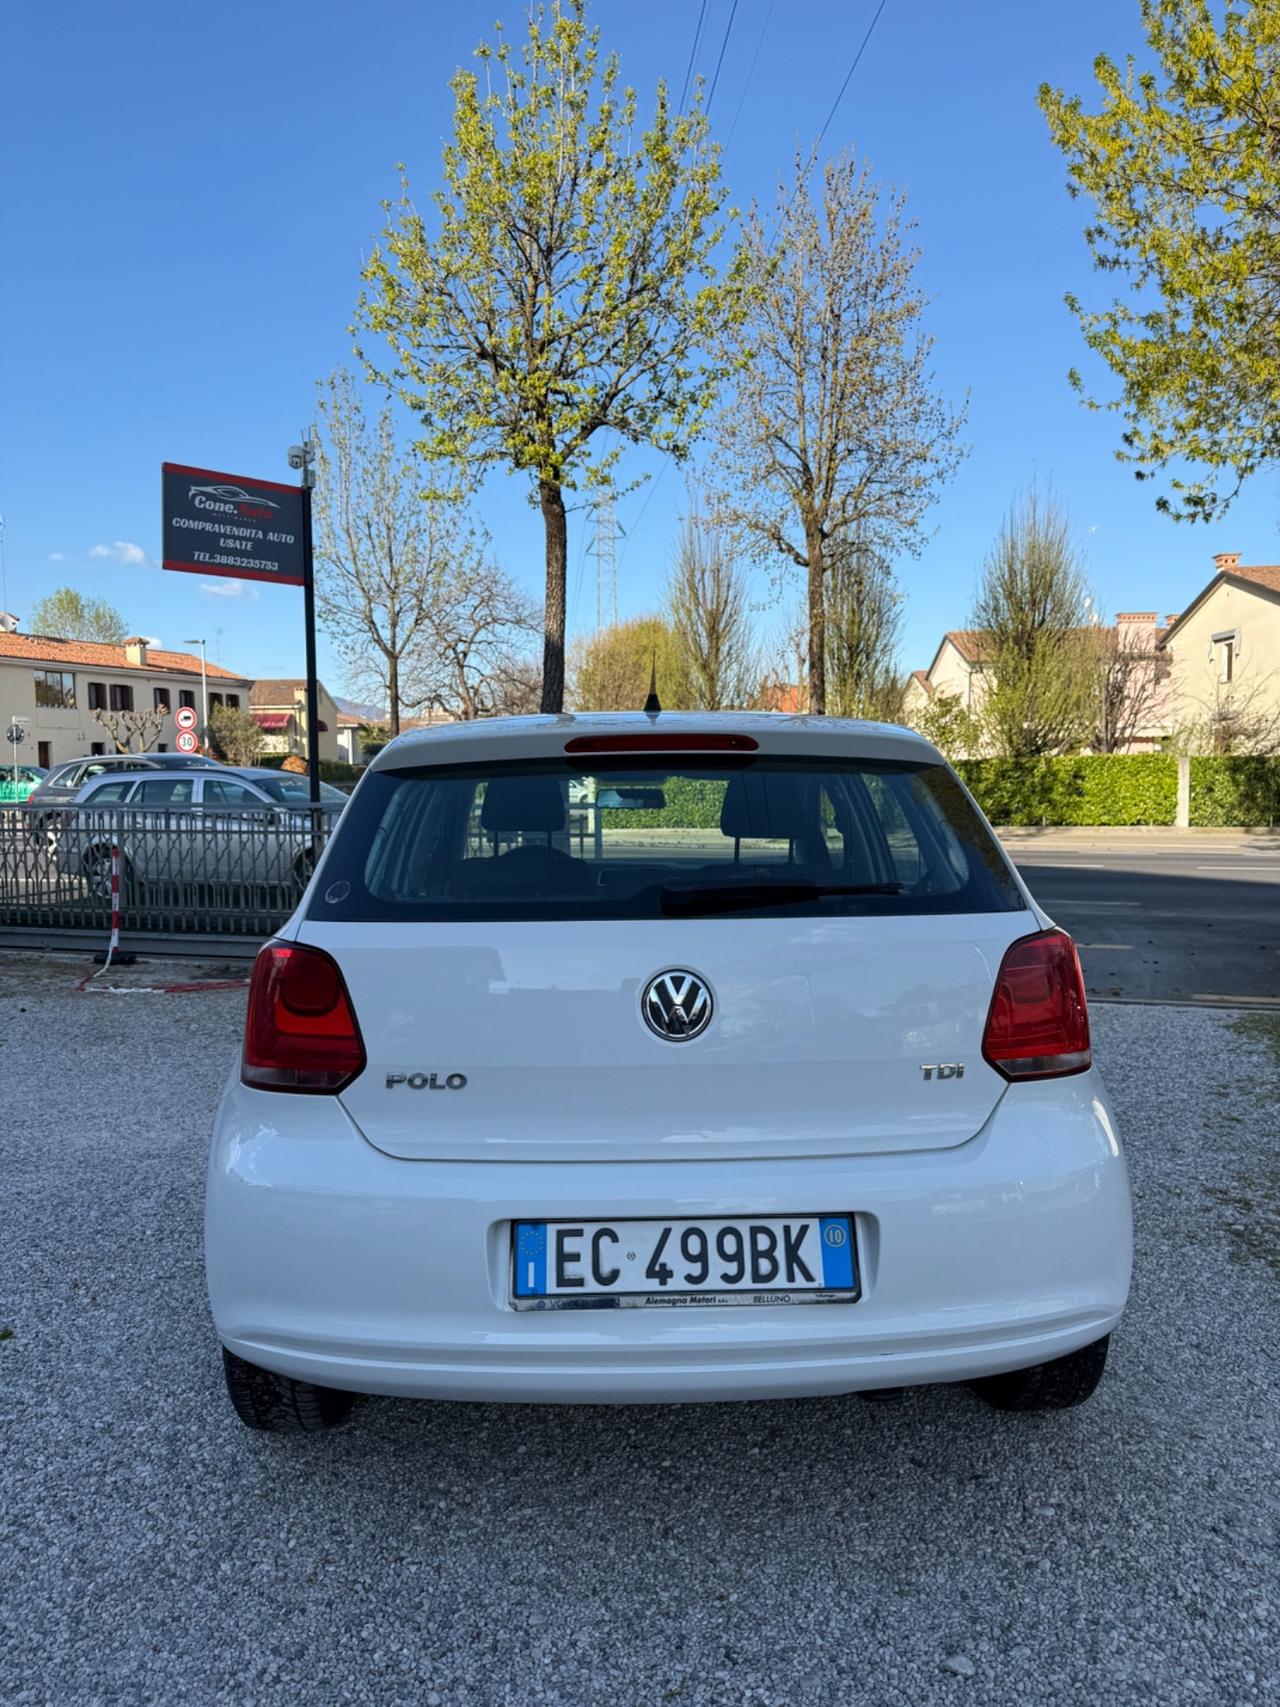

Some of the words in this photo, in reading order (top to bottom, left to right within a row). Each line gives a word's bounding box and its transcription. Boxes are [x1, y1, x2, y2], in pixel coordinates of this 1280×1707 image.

[172, 517, 263, 540] COMPRAVENDITA
[266, 531, 295, 544] AUTO
[219, 538, 254, 551] USATE
[193, 551, 279, 571] TEL.3883235753
[181, 736, 193, 747] 30
[385, 1072, 468, 1090] POLO
[555, 1228, 620, 1288] EC
[645, 1224, 816, 1286] 499BK
[753, 1294, 791, 1304] BELLUNO
